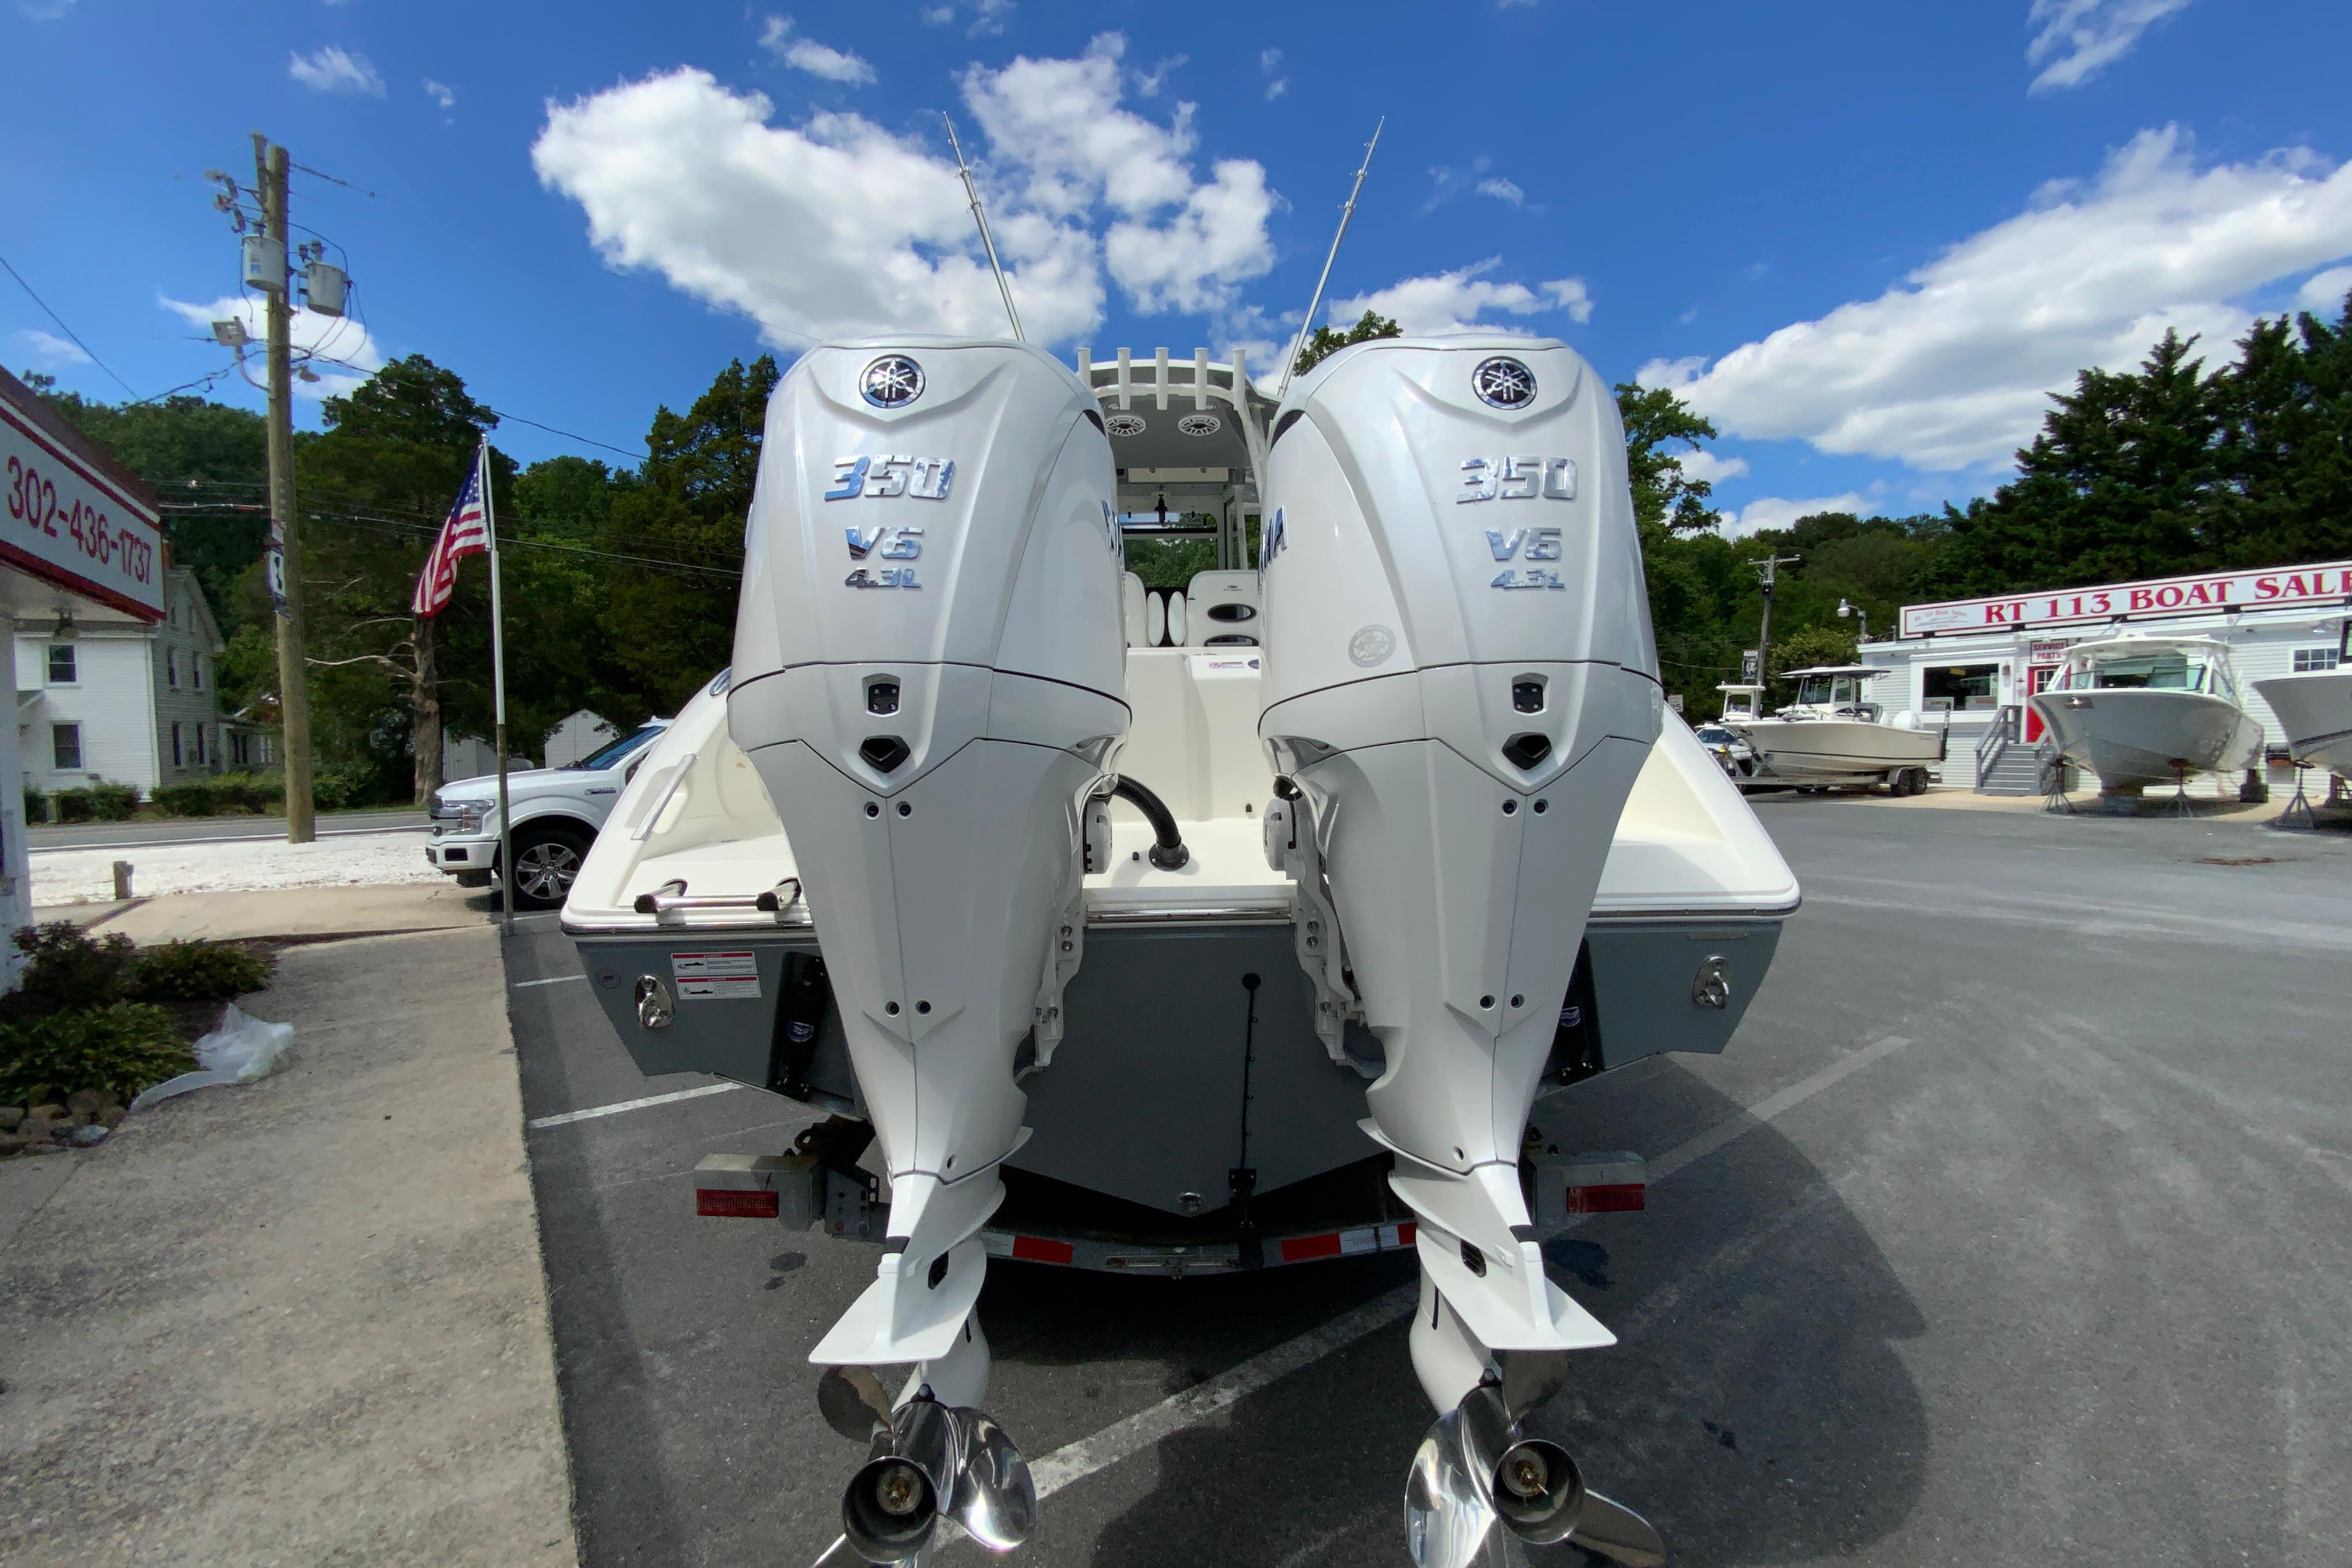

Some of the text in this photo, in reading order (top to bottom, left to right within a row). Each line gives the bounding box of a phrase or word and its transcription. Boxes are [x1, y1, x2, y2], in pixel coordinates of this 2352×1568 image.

[824, 454, 956, 502] 350
[1456, 456, 1577, 503] 350
[8, 456, 152, 584] 302-436-1737
[845, 527, 923, 559] V6
[1485, 527, 1562, 561] V6
[845, 567, 922, 587] 4.3L
[1490, 568, 1564, 589] 4.3L
[1985, 602, 2027, 623] RT
[2045, 593, 2110, 618] 113
[2130, 581, 2234, 610] BOAT
[2034, 642, 2065, 650] SERVICE
